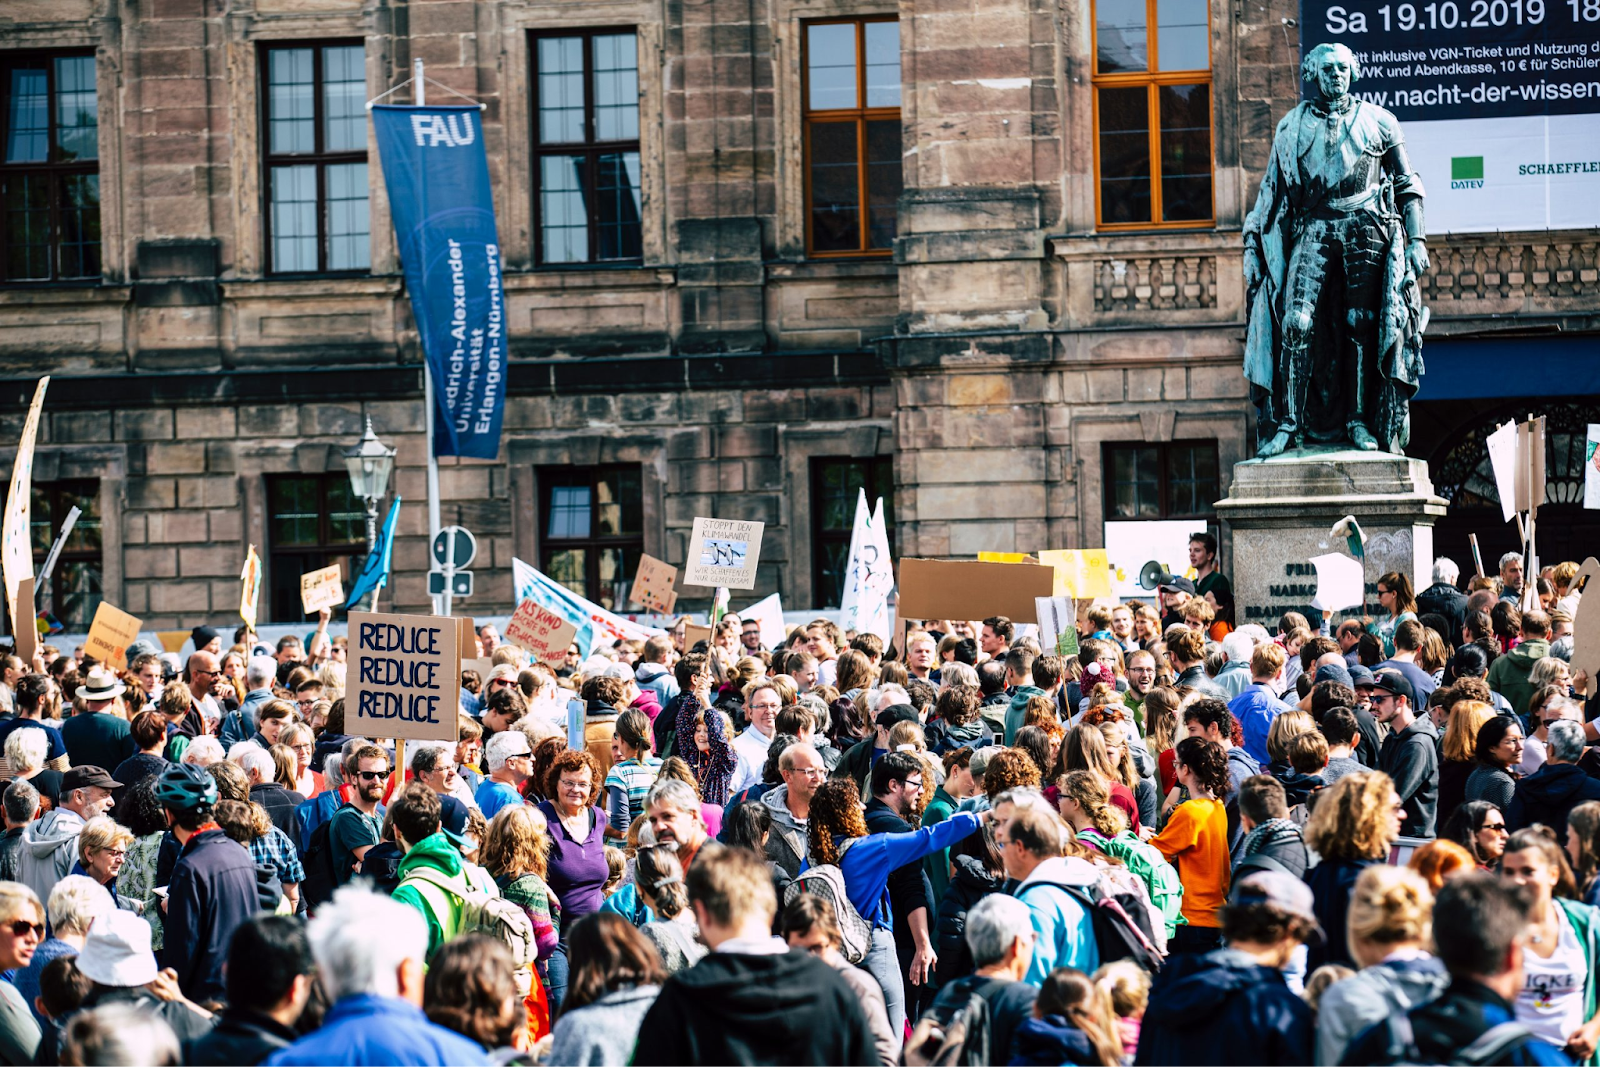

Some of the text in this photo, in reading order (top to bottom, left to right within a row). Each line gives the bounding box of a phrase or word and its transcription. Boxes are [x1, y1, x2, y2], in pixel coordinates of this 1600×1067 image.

[1325, 6, 1368, 34] Sa
[1378, 0, 1545, 31] 19.10.2019
[1372, 50, 1427, 63] inklusive
[1429, 45, 1503, 61] VGN-Ticket
[1506, 44, 1531, 57] und
[1534, 43, 1588, 57] Nutzung
[1387, 65, 1411, 78] und
[1414, 62, 1497, 77] Abendkasse,
[1500, 60, 1515, 72] 10
[1518, 59, 1528, 72] €
[1530, 59, 1548, 72] für
[410, 112, 475, 147] FAU
[1519, 161, 1600, 176] SCHAEFFLE
[1451, 180, 1484, 190] DATEV
[445, 238, 467, 413] edrich-Alexander
[474, 243, 502, 434] Erlangen-Nürnberg
[455, 327, 485, 433] Universität
[701, 530, 752, 542] KLIMAWANDEL
[703, 520, 753, 532] STOPPT DEN
[694, 566, 709, 575] WIR
[517, 599, 538, 617] ALS
[360, 622, 441, 655] REDUCE
[360, 656, 440, 689] REDUCE
[358, 689, 440, 724] REDUCE
